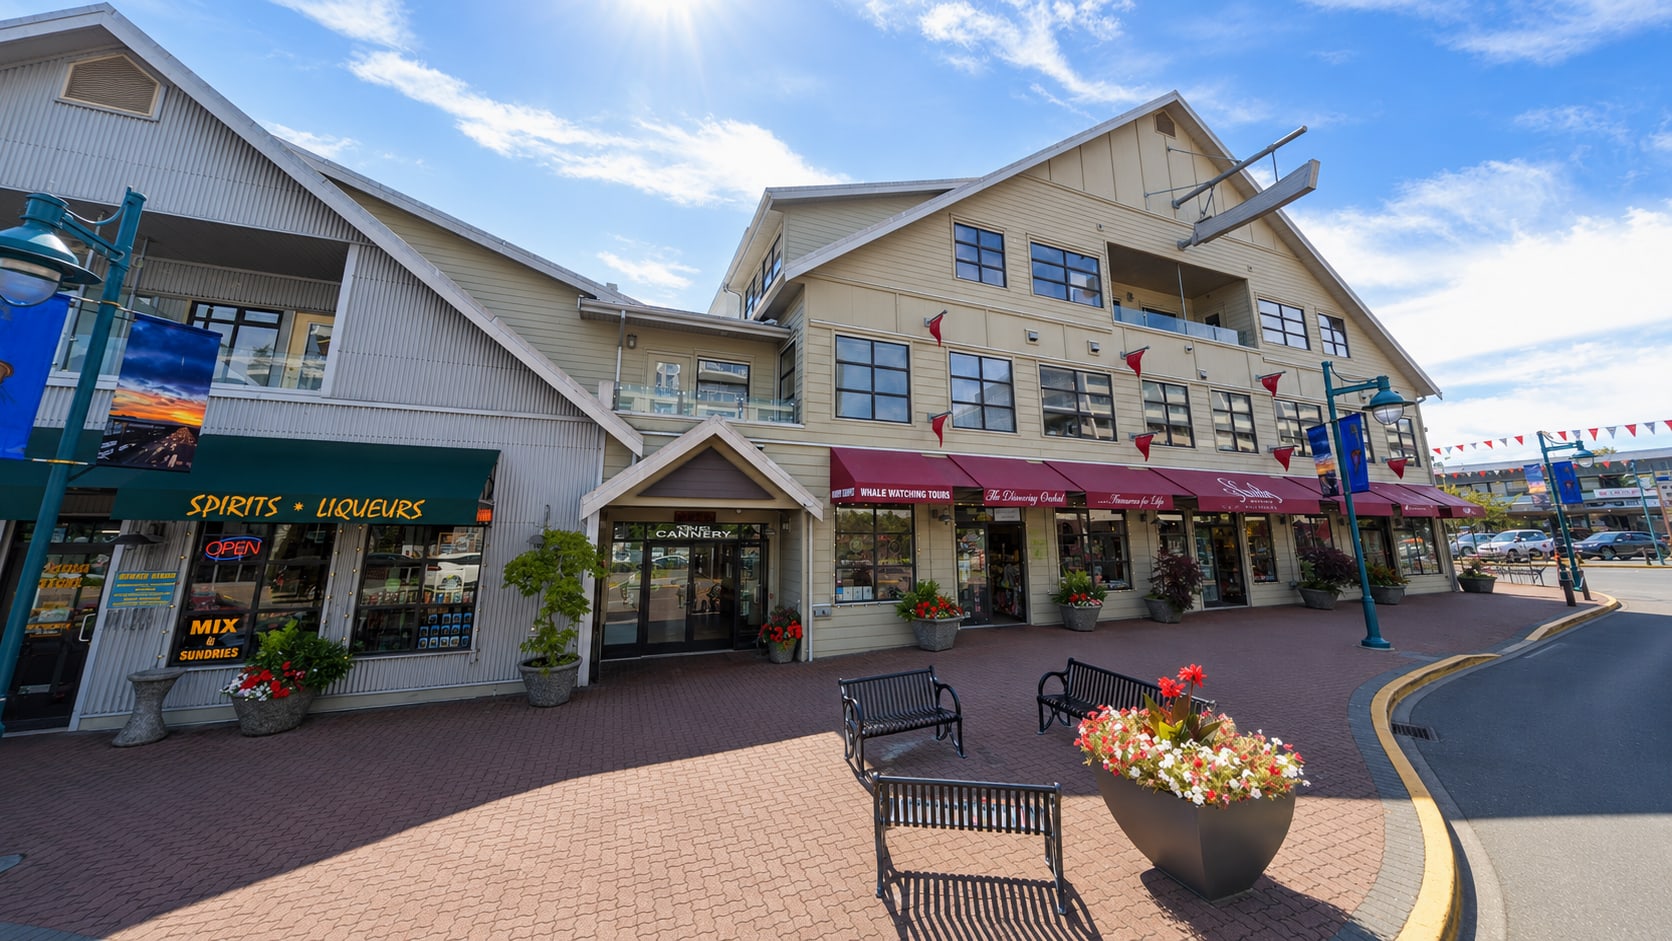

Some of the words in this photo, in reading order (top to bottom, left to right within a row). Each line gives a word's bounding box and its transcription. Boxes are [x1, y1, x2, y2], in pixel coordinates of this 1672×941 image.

[861, 488, 887, 498] WHALE
[888, 489, 927, 499] WATCHING
[928, 490, 951, 499] TOURS
[986, 489, 1001, 501] The
[186, 494, 282, 518] SPIRITS
[316, 497, 426, 520] LIQUEURS
[655, 530, 732, 539] CANNERY
[205, 540, 262, 556] OPEN
[189, 617, 240, 636] MIX
[179, 647, 239, 661] SUNDRIES
